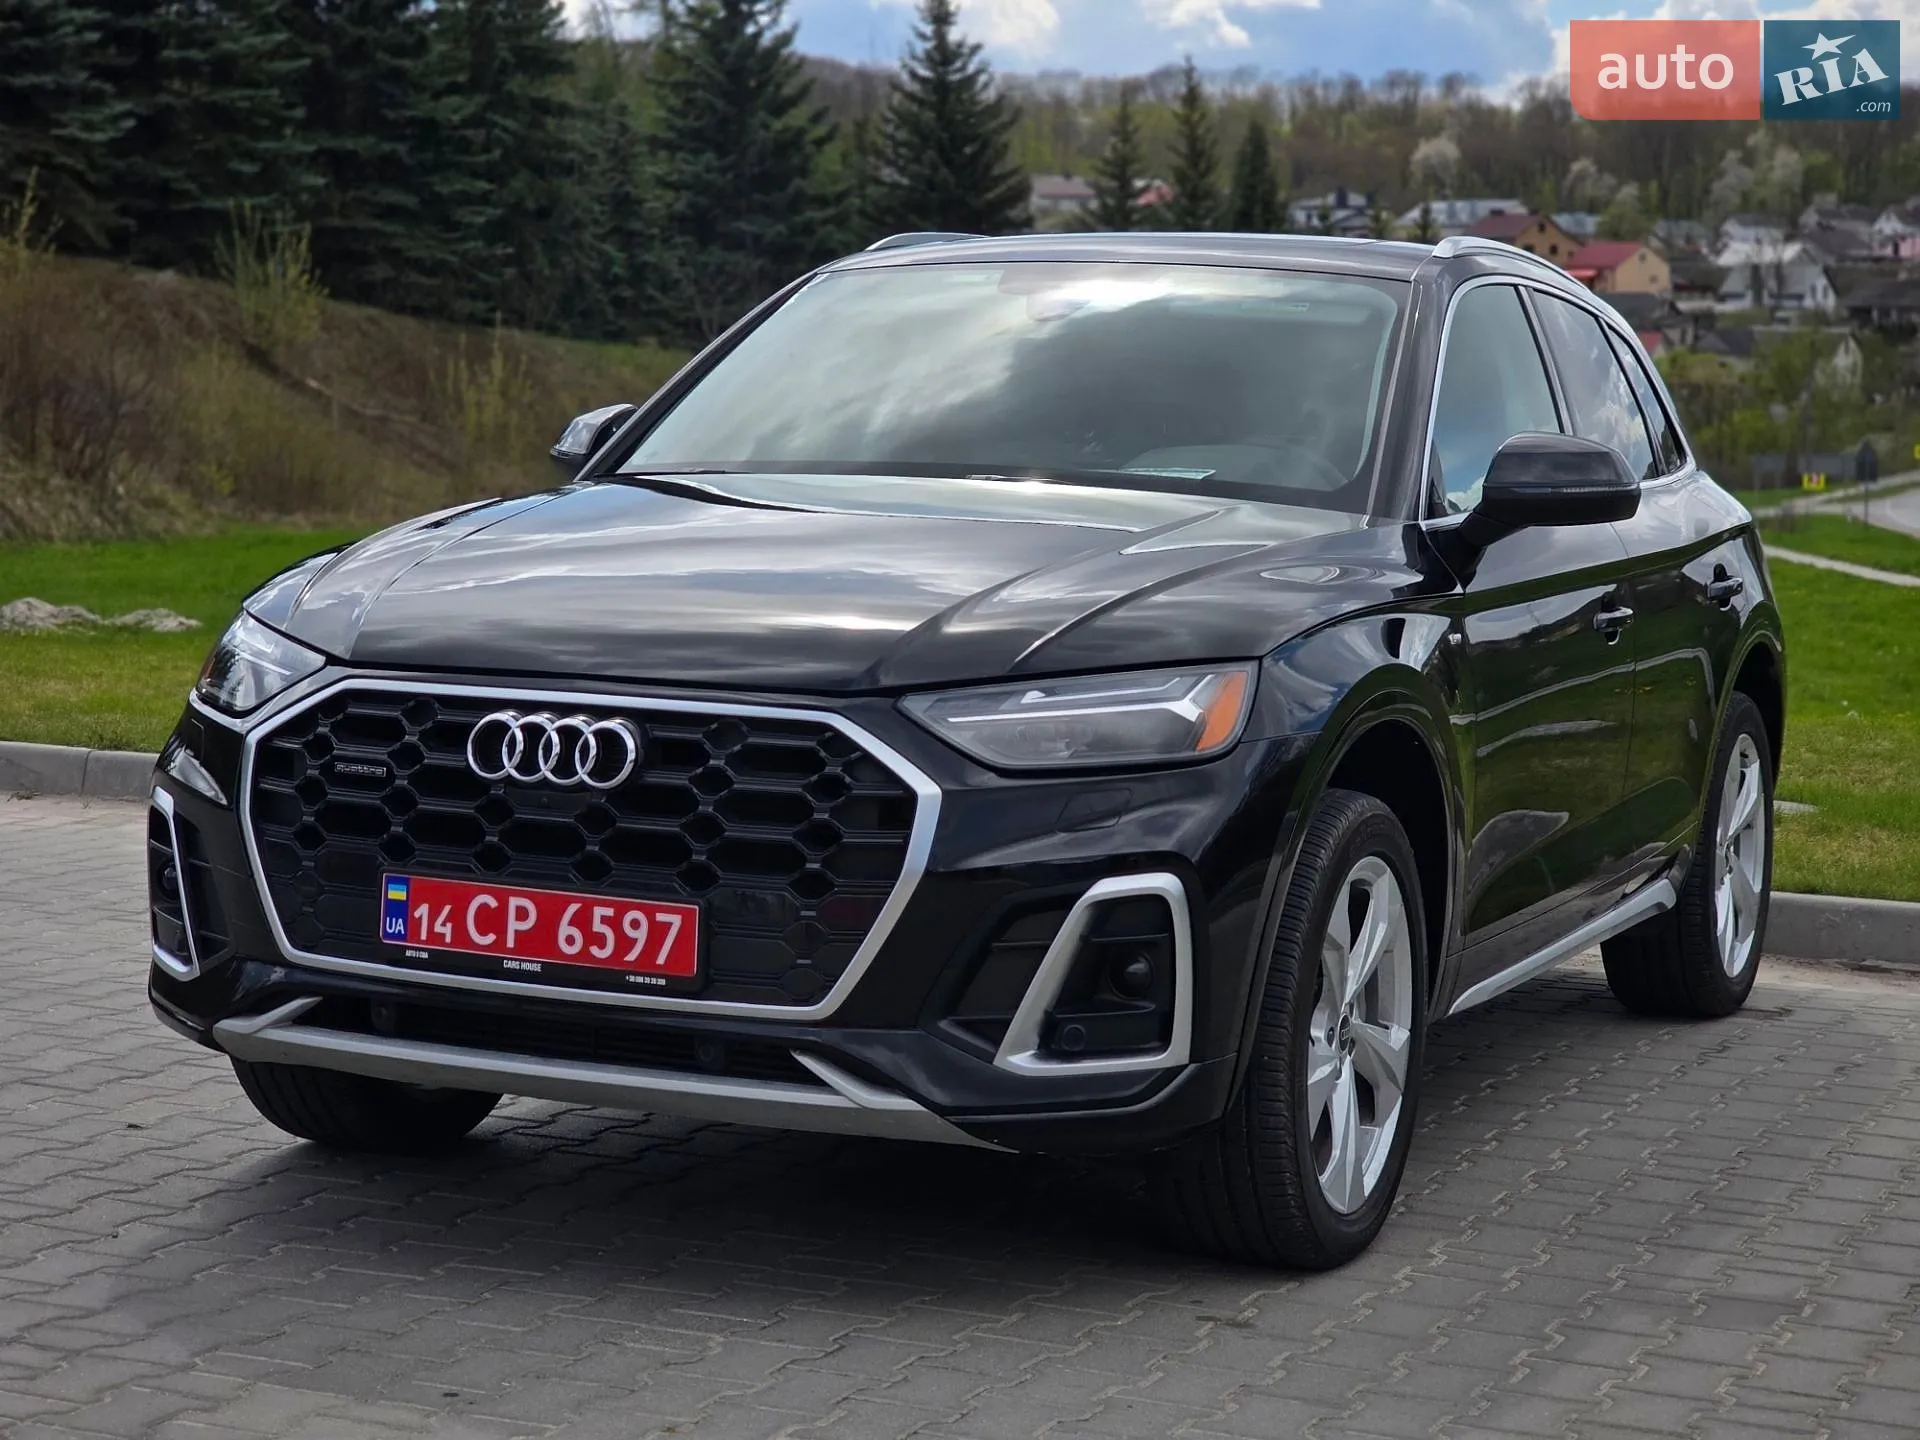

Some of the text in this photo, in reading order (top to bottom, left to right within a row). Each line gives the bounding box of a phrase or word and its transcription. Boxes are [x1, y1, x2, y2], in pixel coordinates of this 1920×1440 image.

[386, 917, 404, 934] UA
[413, 894, 682, 965] 14 CP 6597
[503, 960, 542, 972] CARS HOUSE
